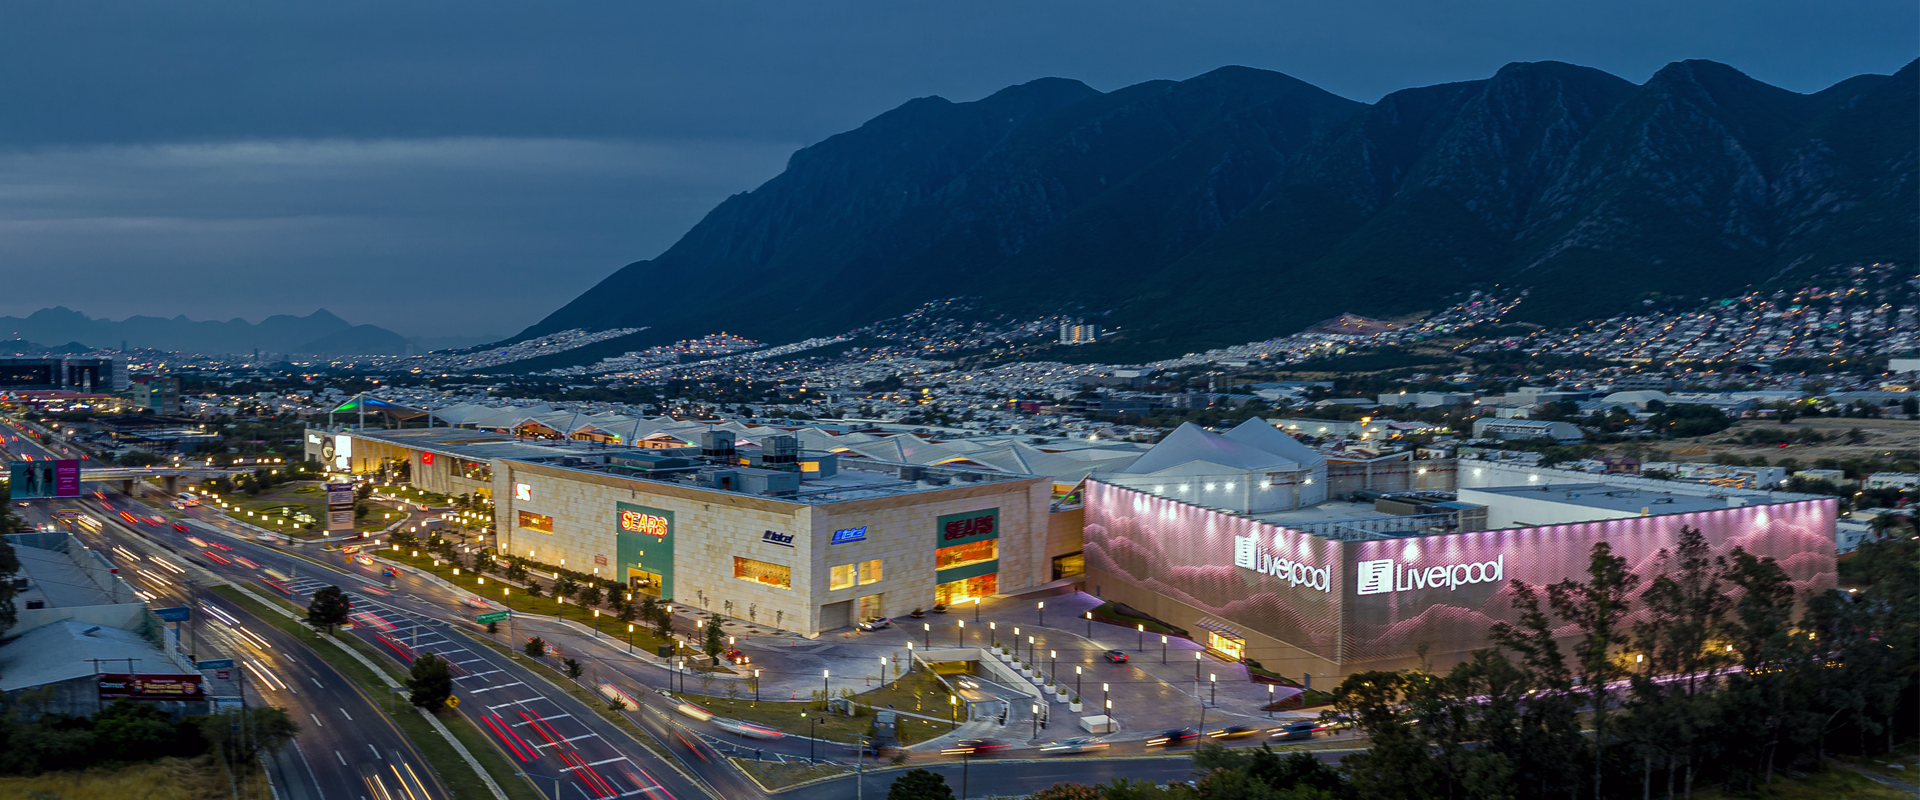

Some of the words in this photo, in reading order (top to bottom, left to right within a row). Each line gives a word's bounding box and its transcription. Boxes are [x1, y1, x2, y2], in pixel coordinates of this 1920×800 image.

[621, 510, 668, 537] SEARS
[944, 515, 995, 541] SEARS
[1257, 546, 1331, 593] Liverpool
[1396, 554, 1503, 591] Liverpool
